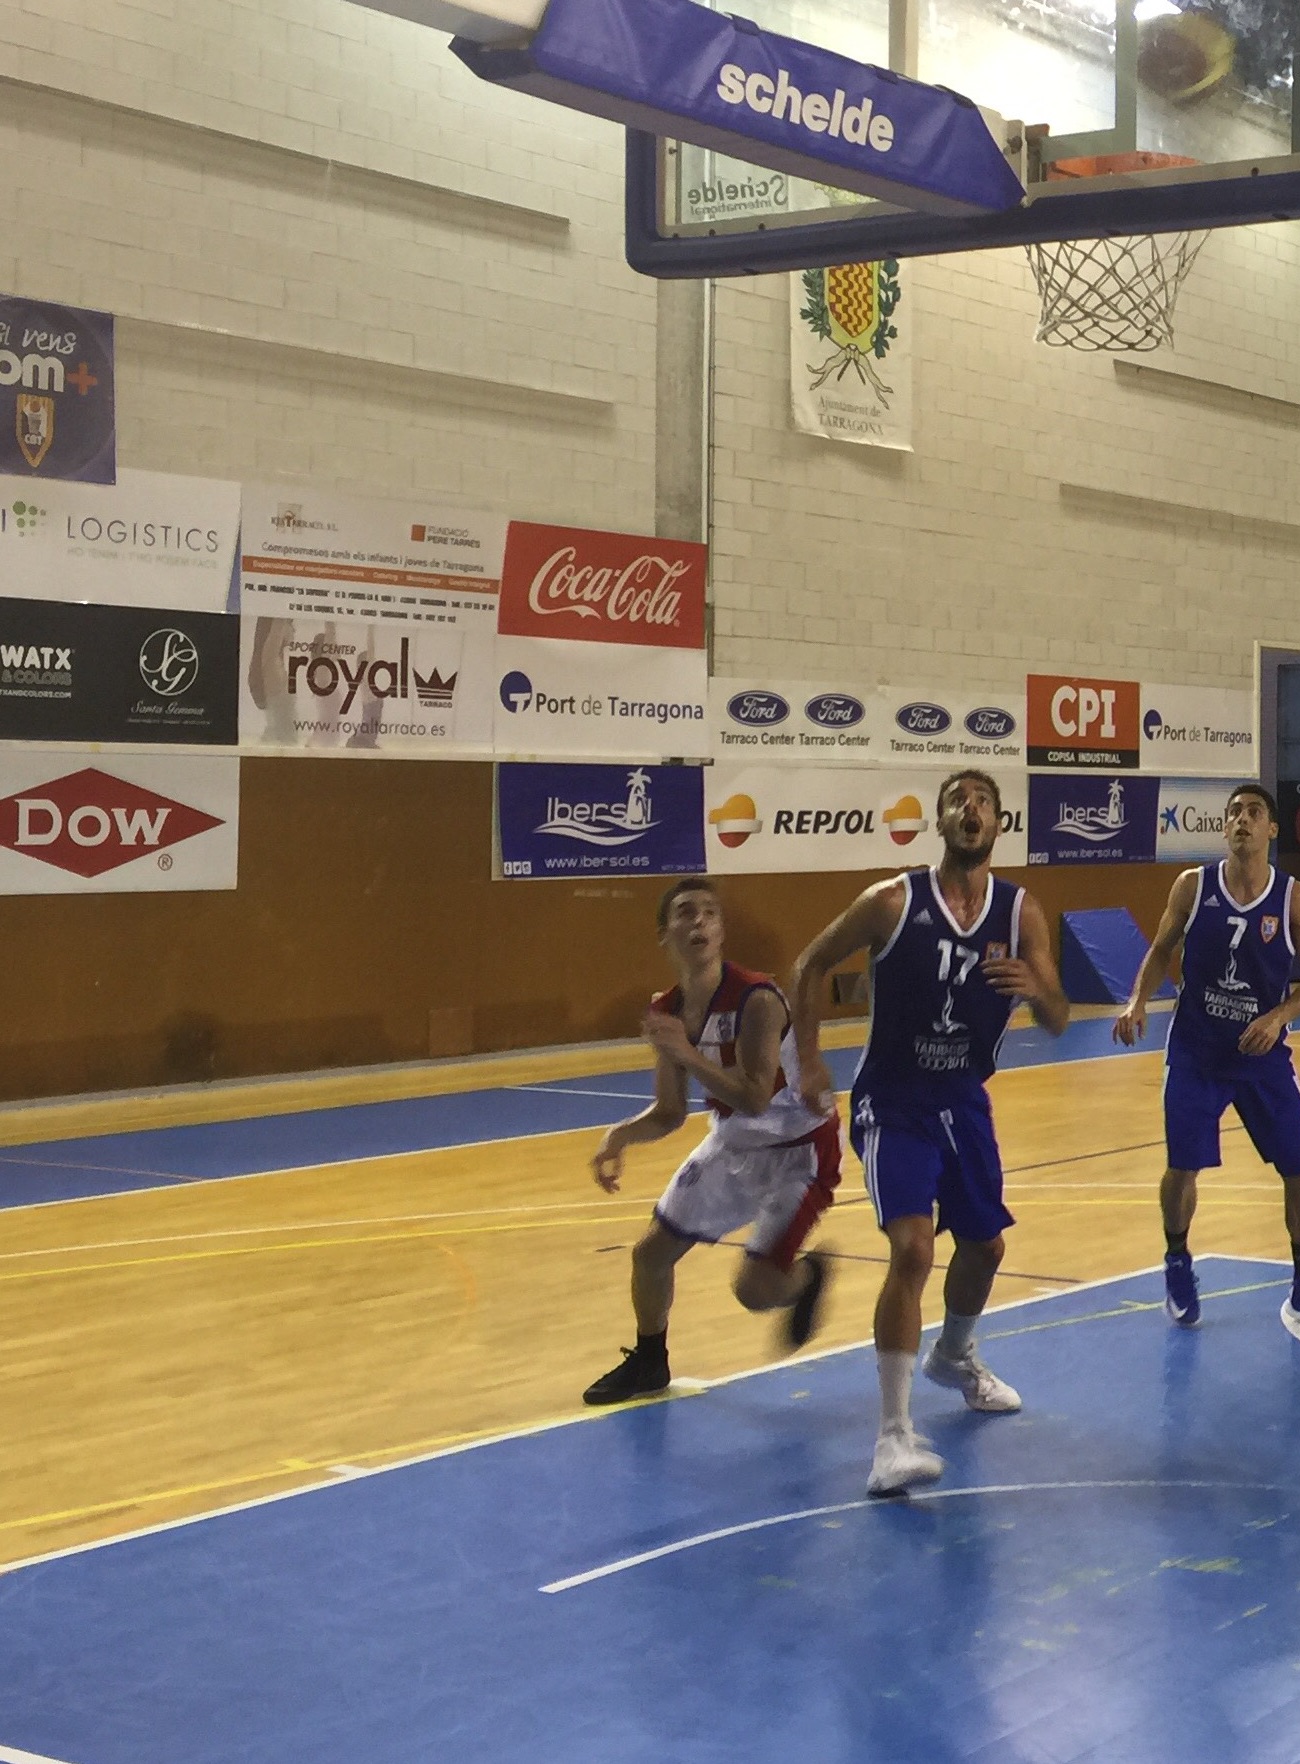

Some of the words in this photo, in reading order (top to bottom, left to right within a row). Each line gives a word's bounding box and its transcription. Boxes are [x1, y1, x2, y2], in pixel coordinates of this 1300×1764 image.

[717, 63, 895, 152] schelde
[870, 405, 881, 417] de
[818, 413, 884, 436] TARRAGONA
[67, 516, 219, 553] LOGISTICS
[262, 542, 329, 559] Compromesos
[331, 550, 350, 561] amb
[367, 554, 398, 565] infants
[404, 557, 427, 568] joves
[429, 559, 440, 568] de
[442, 560, 484, 573] Tarragona
[529, 546, 691, 626] Coca-Cola
[321, 644, 356, 655] CENTER
[288, 637, 409, 715] royal
[536, 693, 576, 714] Port
[581, 695, 602, 715] de
[608, 696, 704, 723] Tarragona
[739, 697, 777, 719] Ford
[817, 700, 854, 722] Ford
[1051, 685, 1116, 738] CPI
[908, 709, 941, 730] Ford
[975, 713, 1006, 733] Ford
[720, 731, 758, 745] Tarraco
[761, 733, 795, 745] Center
[799, 733, 836, 746] Tarraco
[838, 733, 870, 746] Center
[890, 739, 925, 753] Tarraco
[926, 741, 955, 753] Center
[1163, 725, 1186, 742] Port
[1189, 726, 1201, 742] de
[1203, 727, 1252, 747] Tarragona
[959, 742, 991, 755] Tarraco
[993, 744, 1020, 756] Center
[773, 810, 875, 835] REPSOL
[544, 855, 650, 869] www.ibersol.es
[1227, 916, 1248, 950] 7
[938, 938, 979, 986] 17
